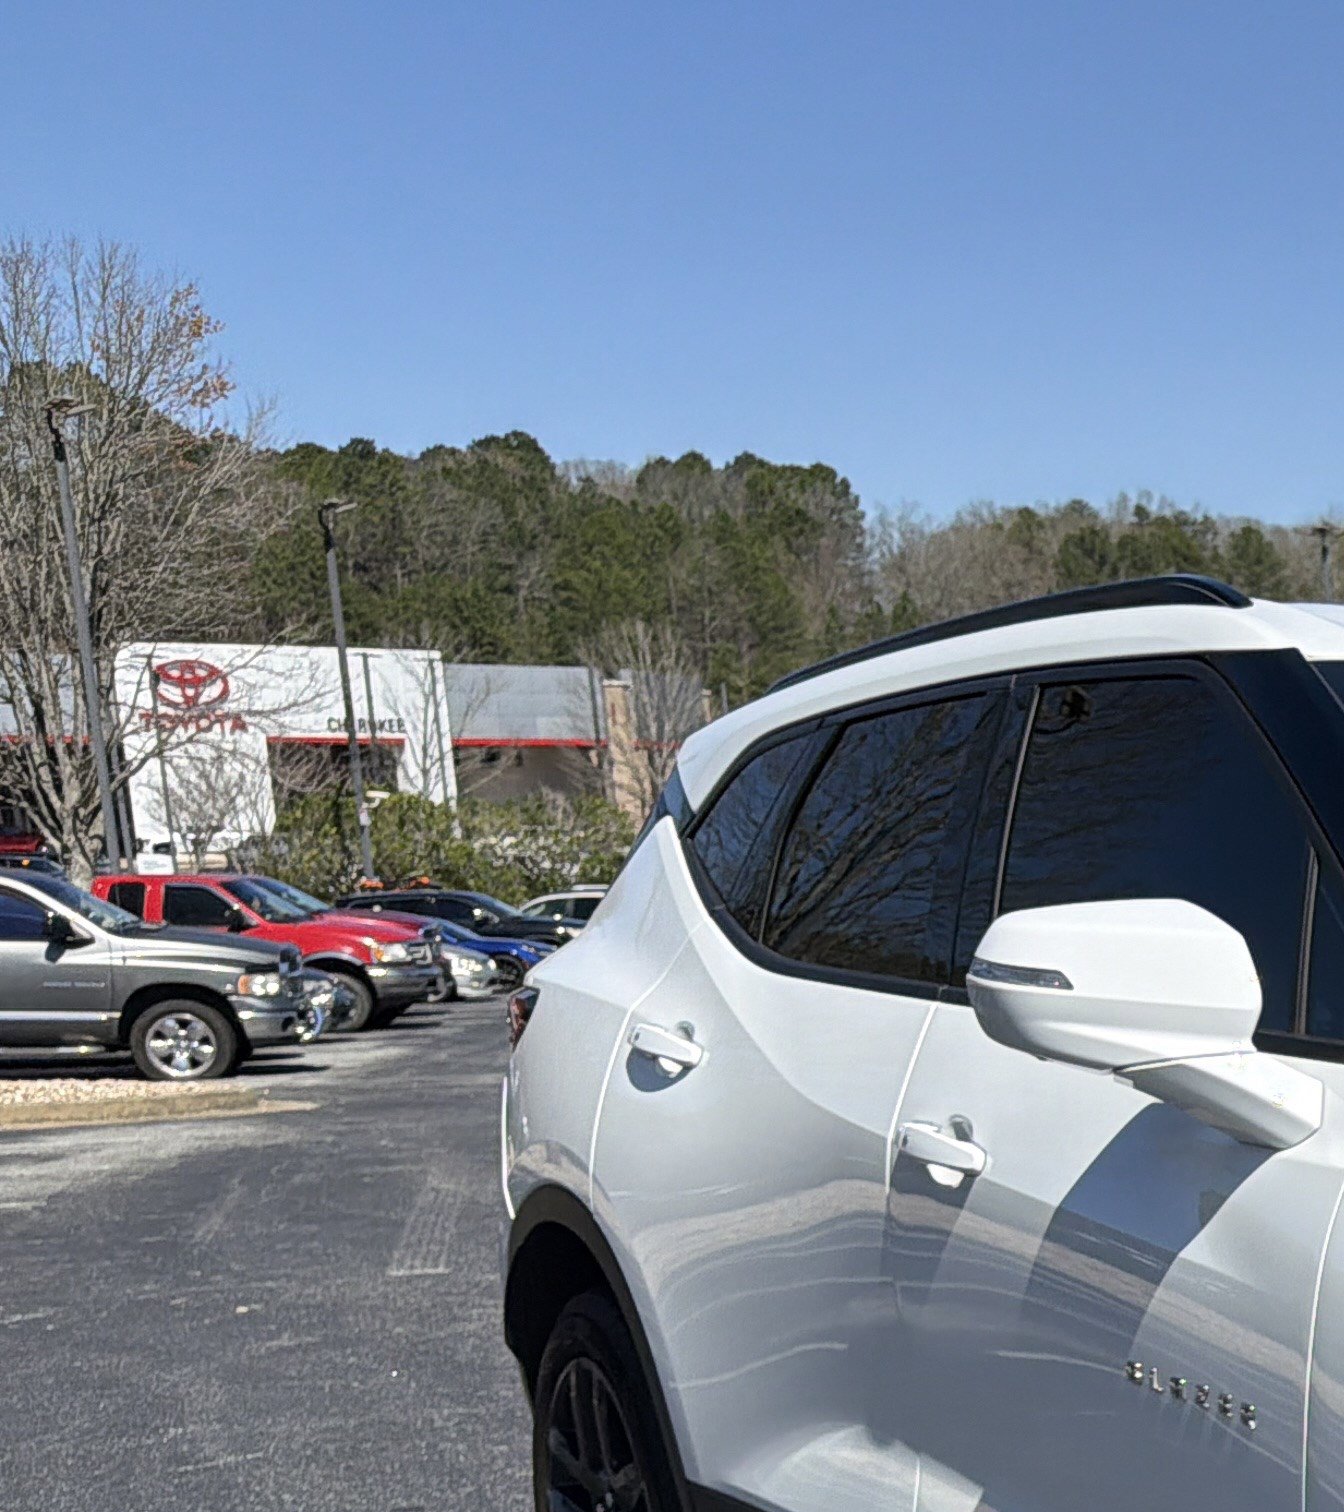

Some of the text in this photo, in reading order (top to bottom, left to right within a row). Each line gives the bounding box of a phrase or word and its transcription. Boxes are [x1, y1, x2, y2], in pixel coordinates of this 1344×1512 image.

[138, 711, 249, 735] TOYOTA
[327, 716, 406, 733] CHRKEE
[1125, 1360, 1257, 1431] BLAZER
